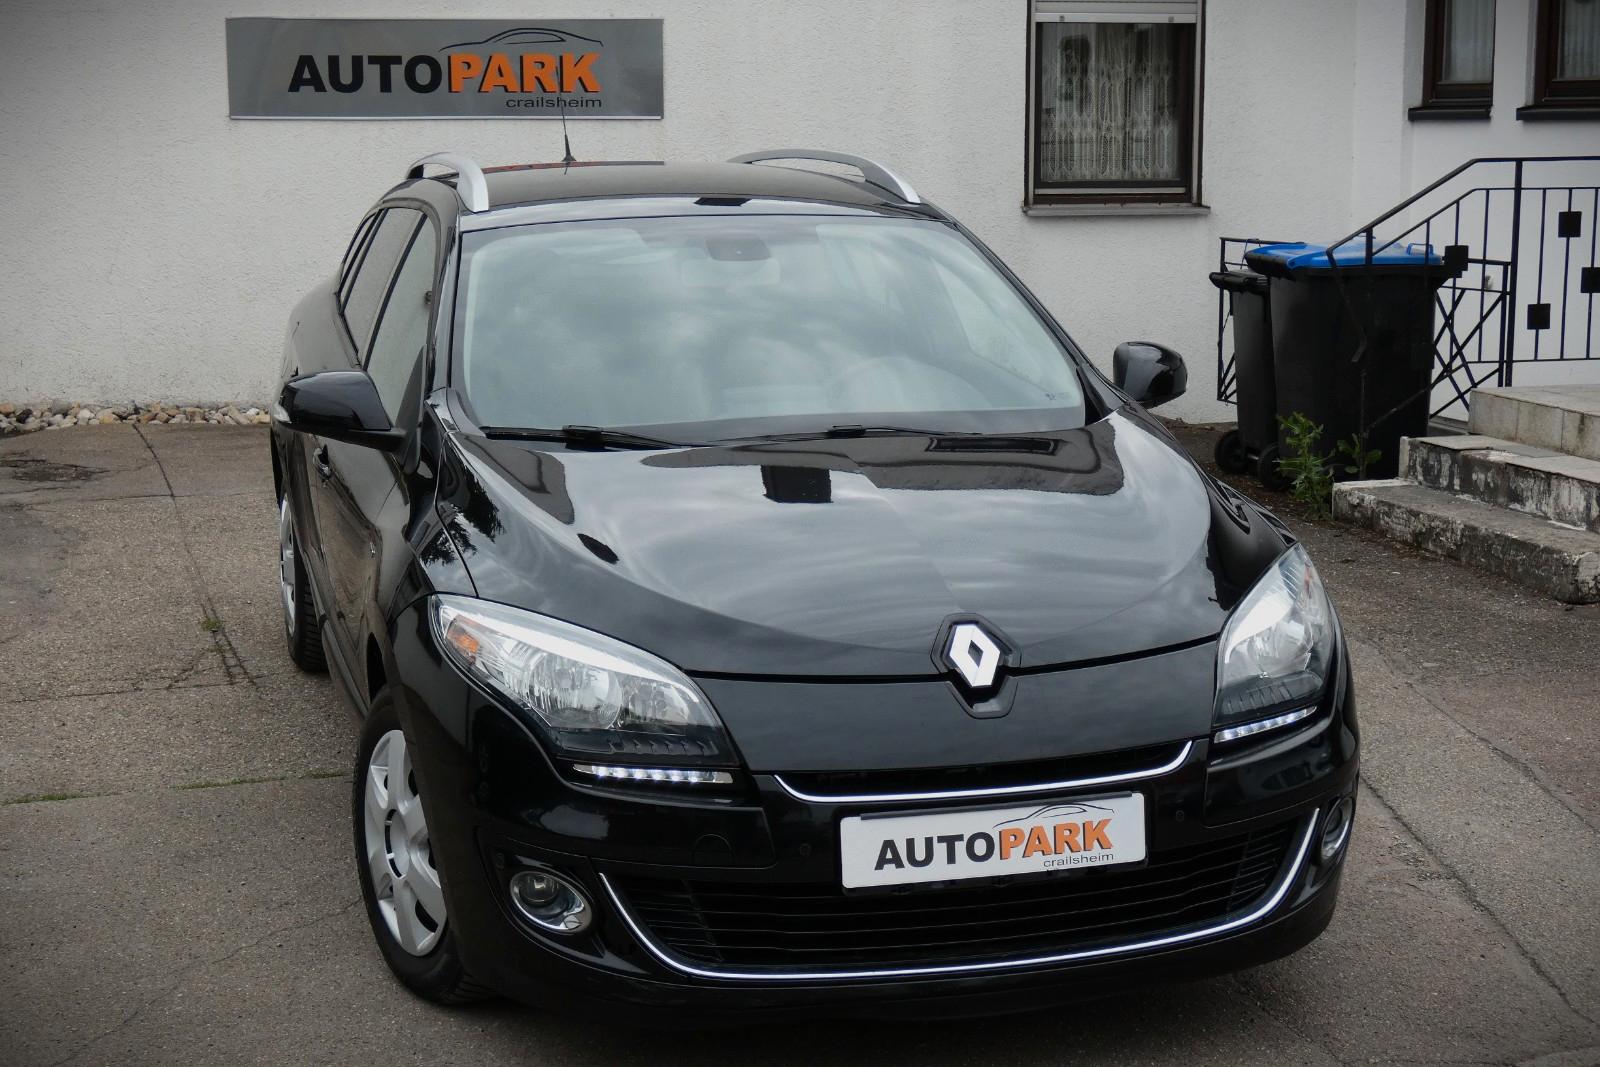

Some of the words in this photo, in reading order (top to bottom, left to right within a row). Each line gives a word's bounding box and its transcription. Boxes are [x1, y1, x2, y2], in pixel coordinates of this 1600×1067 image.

[288, 54, 601, 93] AUTOPARK
[506, 97, 602, 108] crailsheim
[874, 819, 1113, 870] AUTOPARK
[1043, 852, 1114, 868] crailsheim
